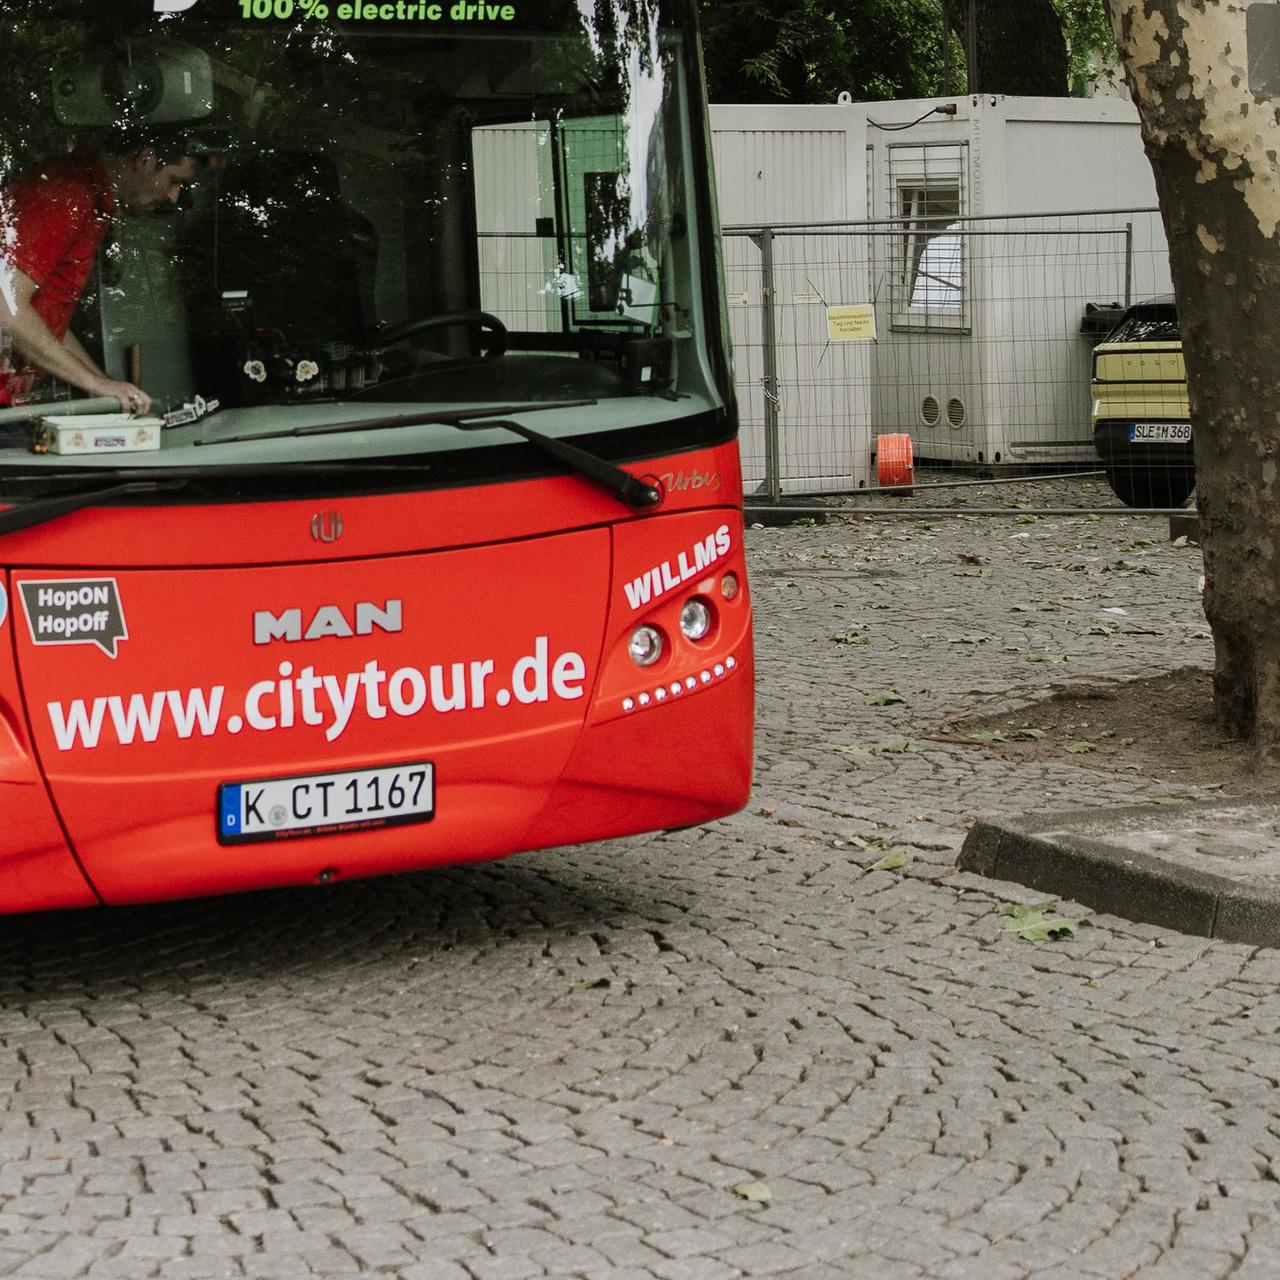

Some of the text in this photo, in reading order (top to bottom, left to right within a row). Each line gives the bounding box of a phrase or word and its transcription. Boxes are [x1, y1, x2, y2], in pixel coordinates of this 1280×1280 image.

[337, 0, 442, 21] electric
[450, 0, 516, 21] drive
[833, 320, 842, 328] Tag
[1135, 425, 1191, 438] SLE M 368
[623, 524, 731, 610] WILLMS
[38, 586, 109, 611] HopON
[38, 610, 109, 638] HopOff
[253, 598, 402, 645] MAN
[46, 636, 586, 752] www.citytour.de
[245, 770, 426, 825] K CT 1167
[226, 814, 236, 827] D
